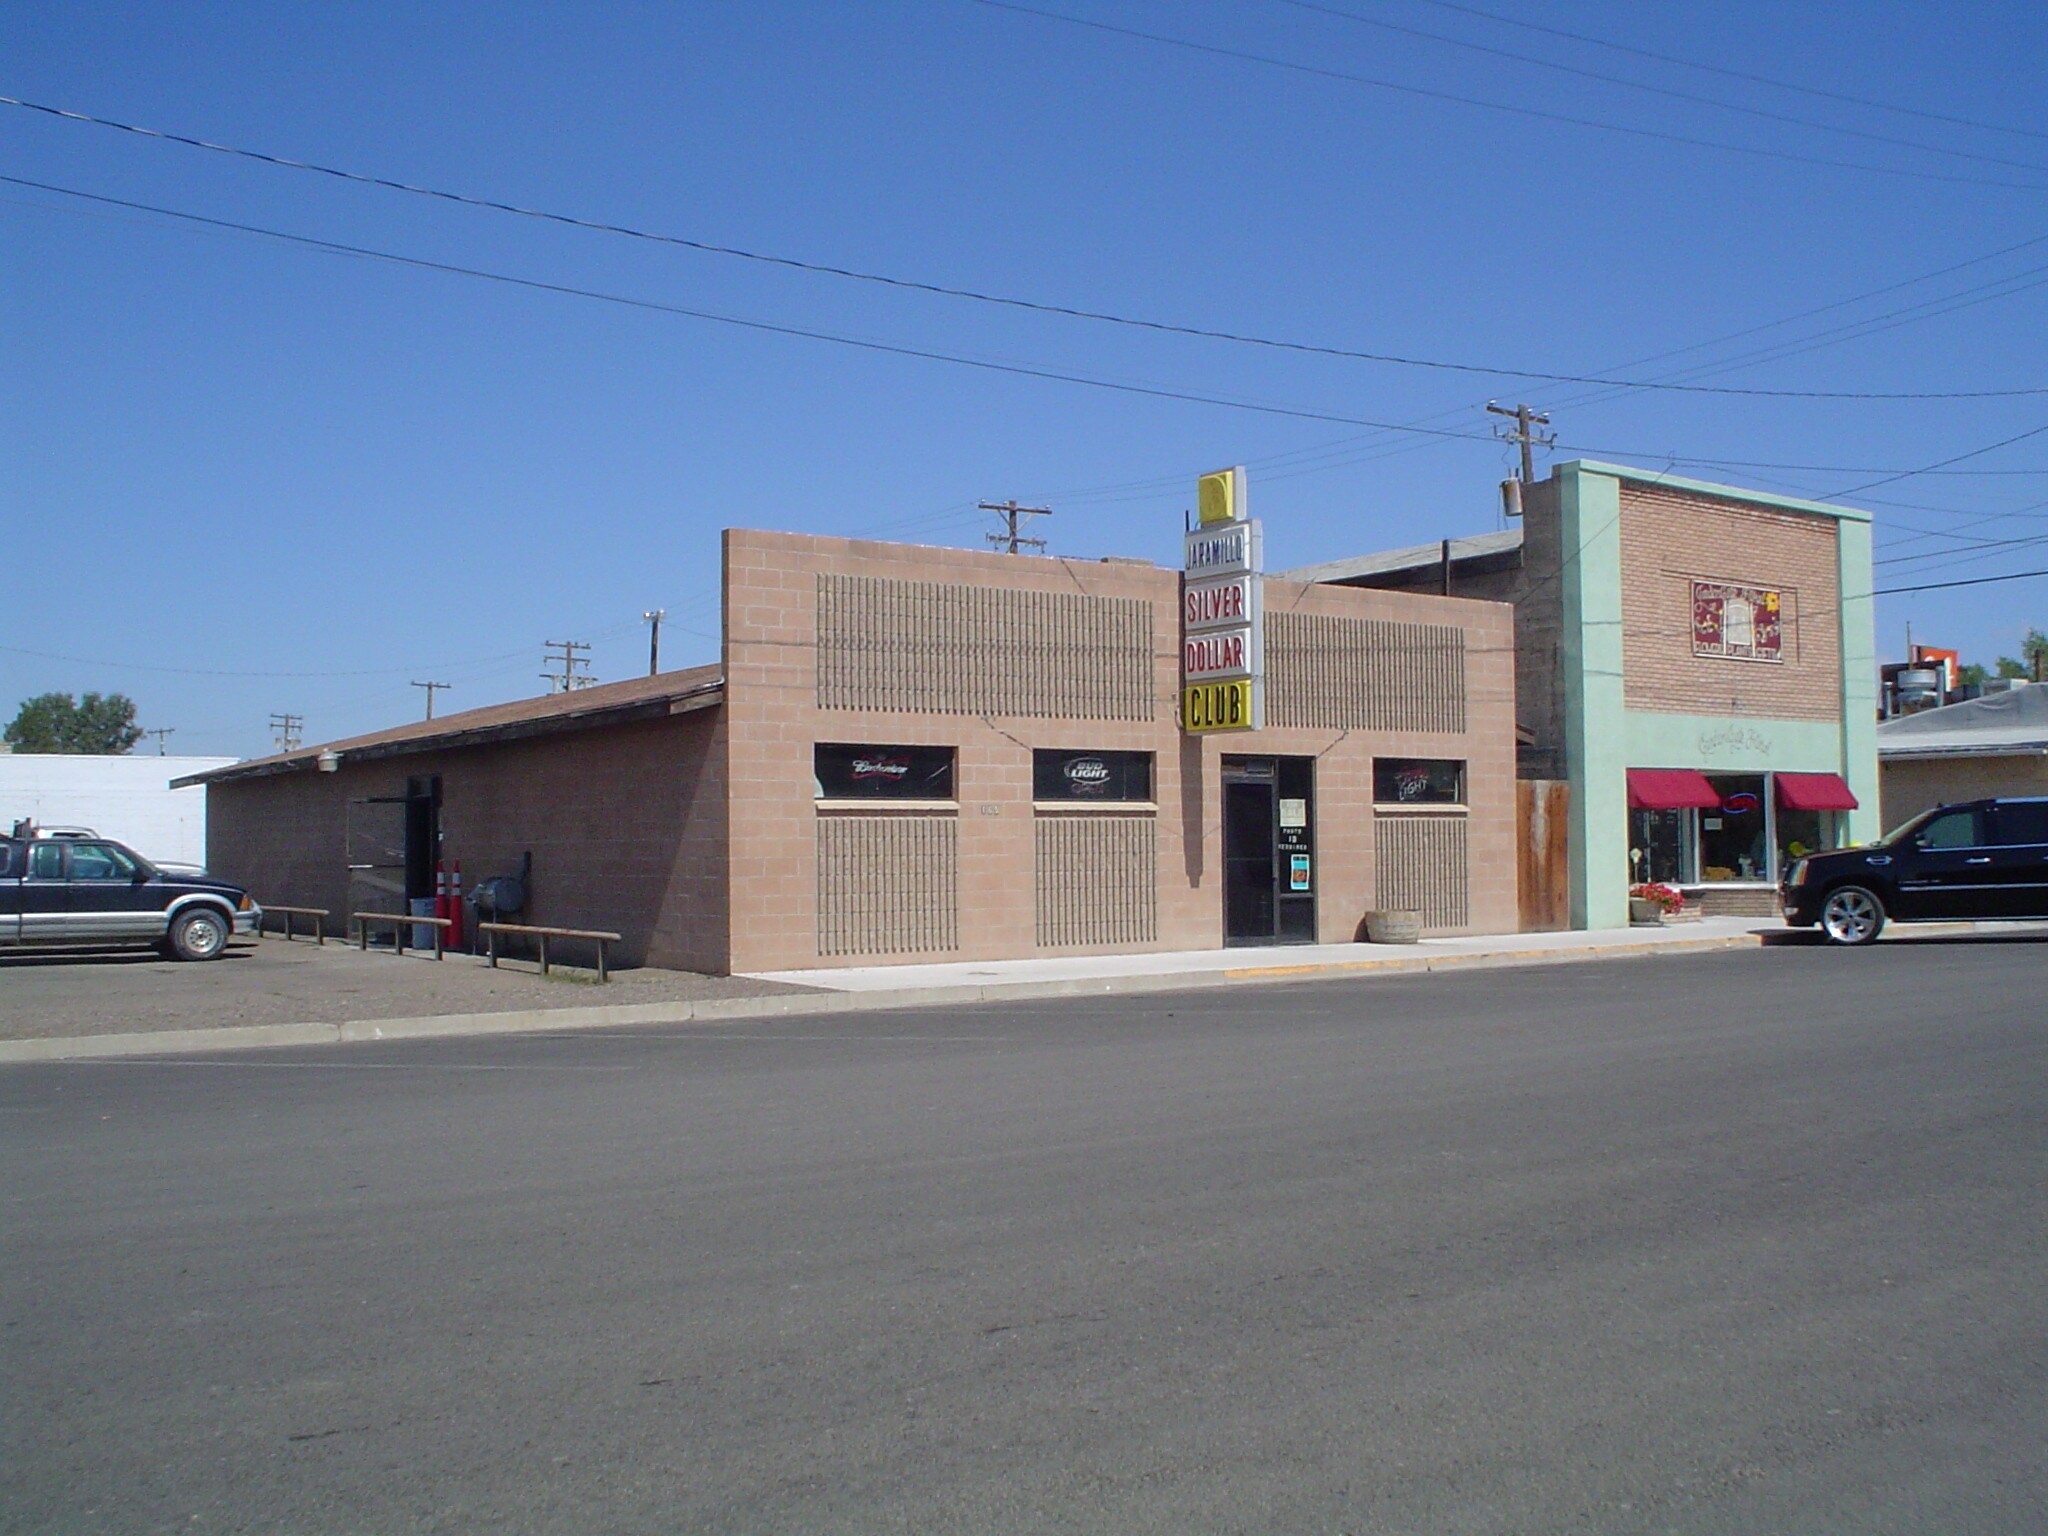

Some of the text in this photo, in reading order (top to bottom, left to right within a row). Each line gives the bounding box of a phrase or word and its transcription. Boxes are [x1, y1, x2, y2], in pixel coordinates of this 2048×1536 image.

[1185, 532, 1242, 571] JARAMILLO
[1187, 584, 1243, 623] SILVER
[1186, 635, 1243, 673] DOLLAR
[1190, 684, 1240, 727] CLUB
[1070, 769, 1109, 778] LIGHT
[1076, 761, 1104, 770] BUD
[1399, 777, 1428, 801] LIGHT
[1288, 835, 1298, 843] ID
